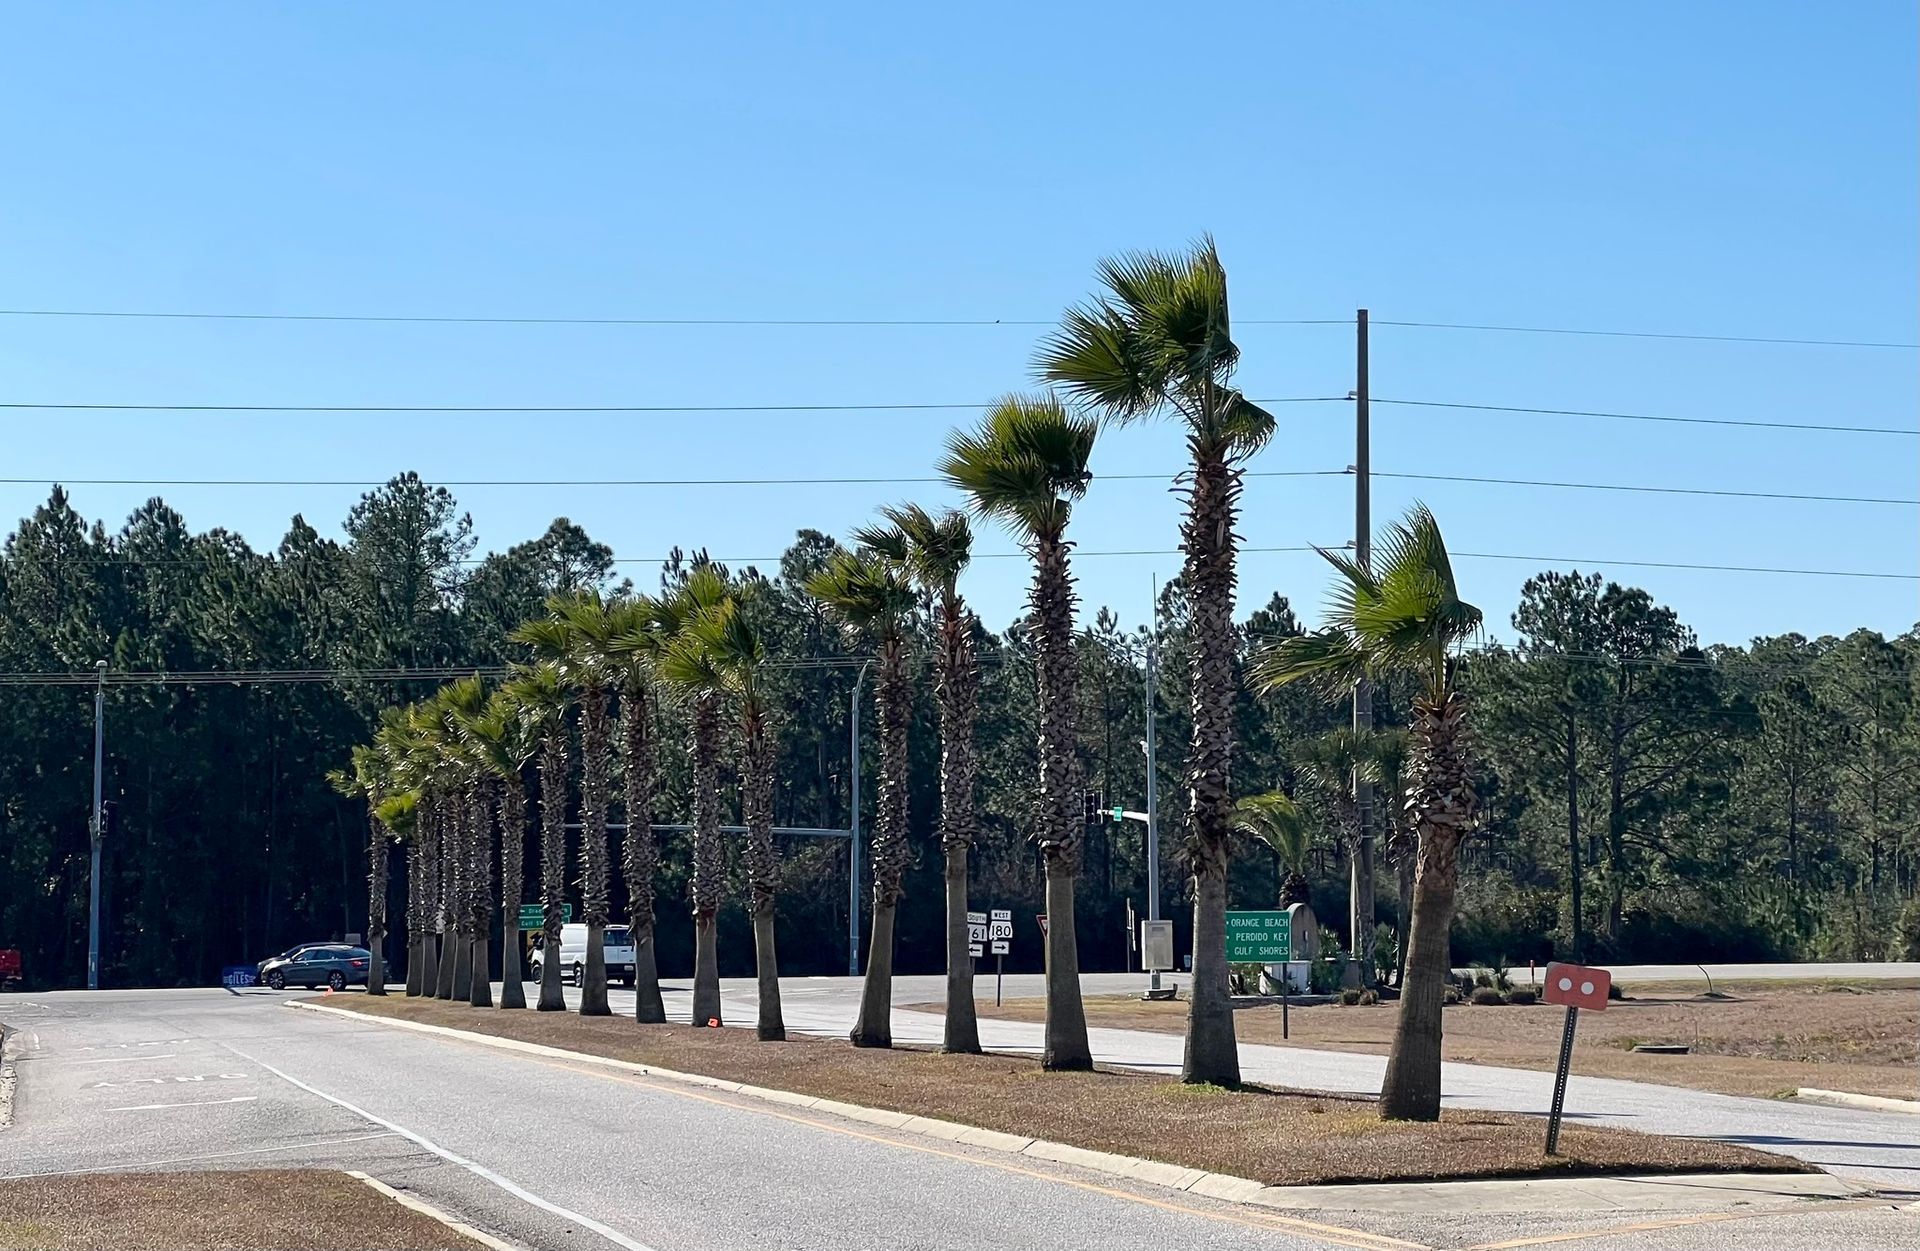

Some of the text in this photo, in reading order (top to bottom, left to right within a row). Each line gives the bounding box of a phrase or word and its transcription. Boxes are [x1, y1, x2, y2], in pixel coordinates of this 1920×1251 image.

[1231, 918, 1288, 927] ORANGE BEACH
[991, 925, 1011, 937] 180
[1235, 932, 1288, 942] PERDIDO KEY
[1234, 946, 1288, 956] GULF SHORES
